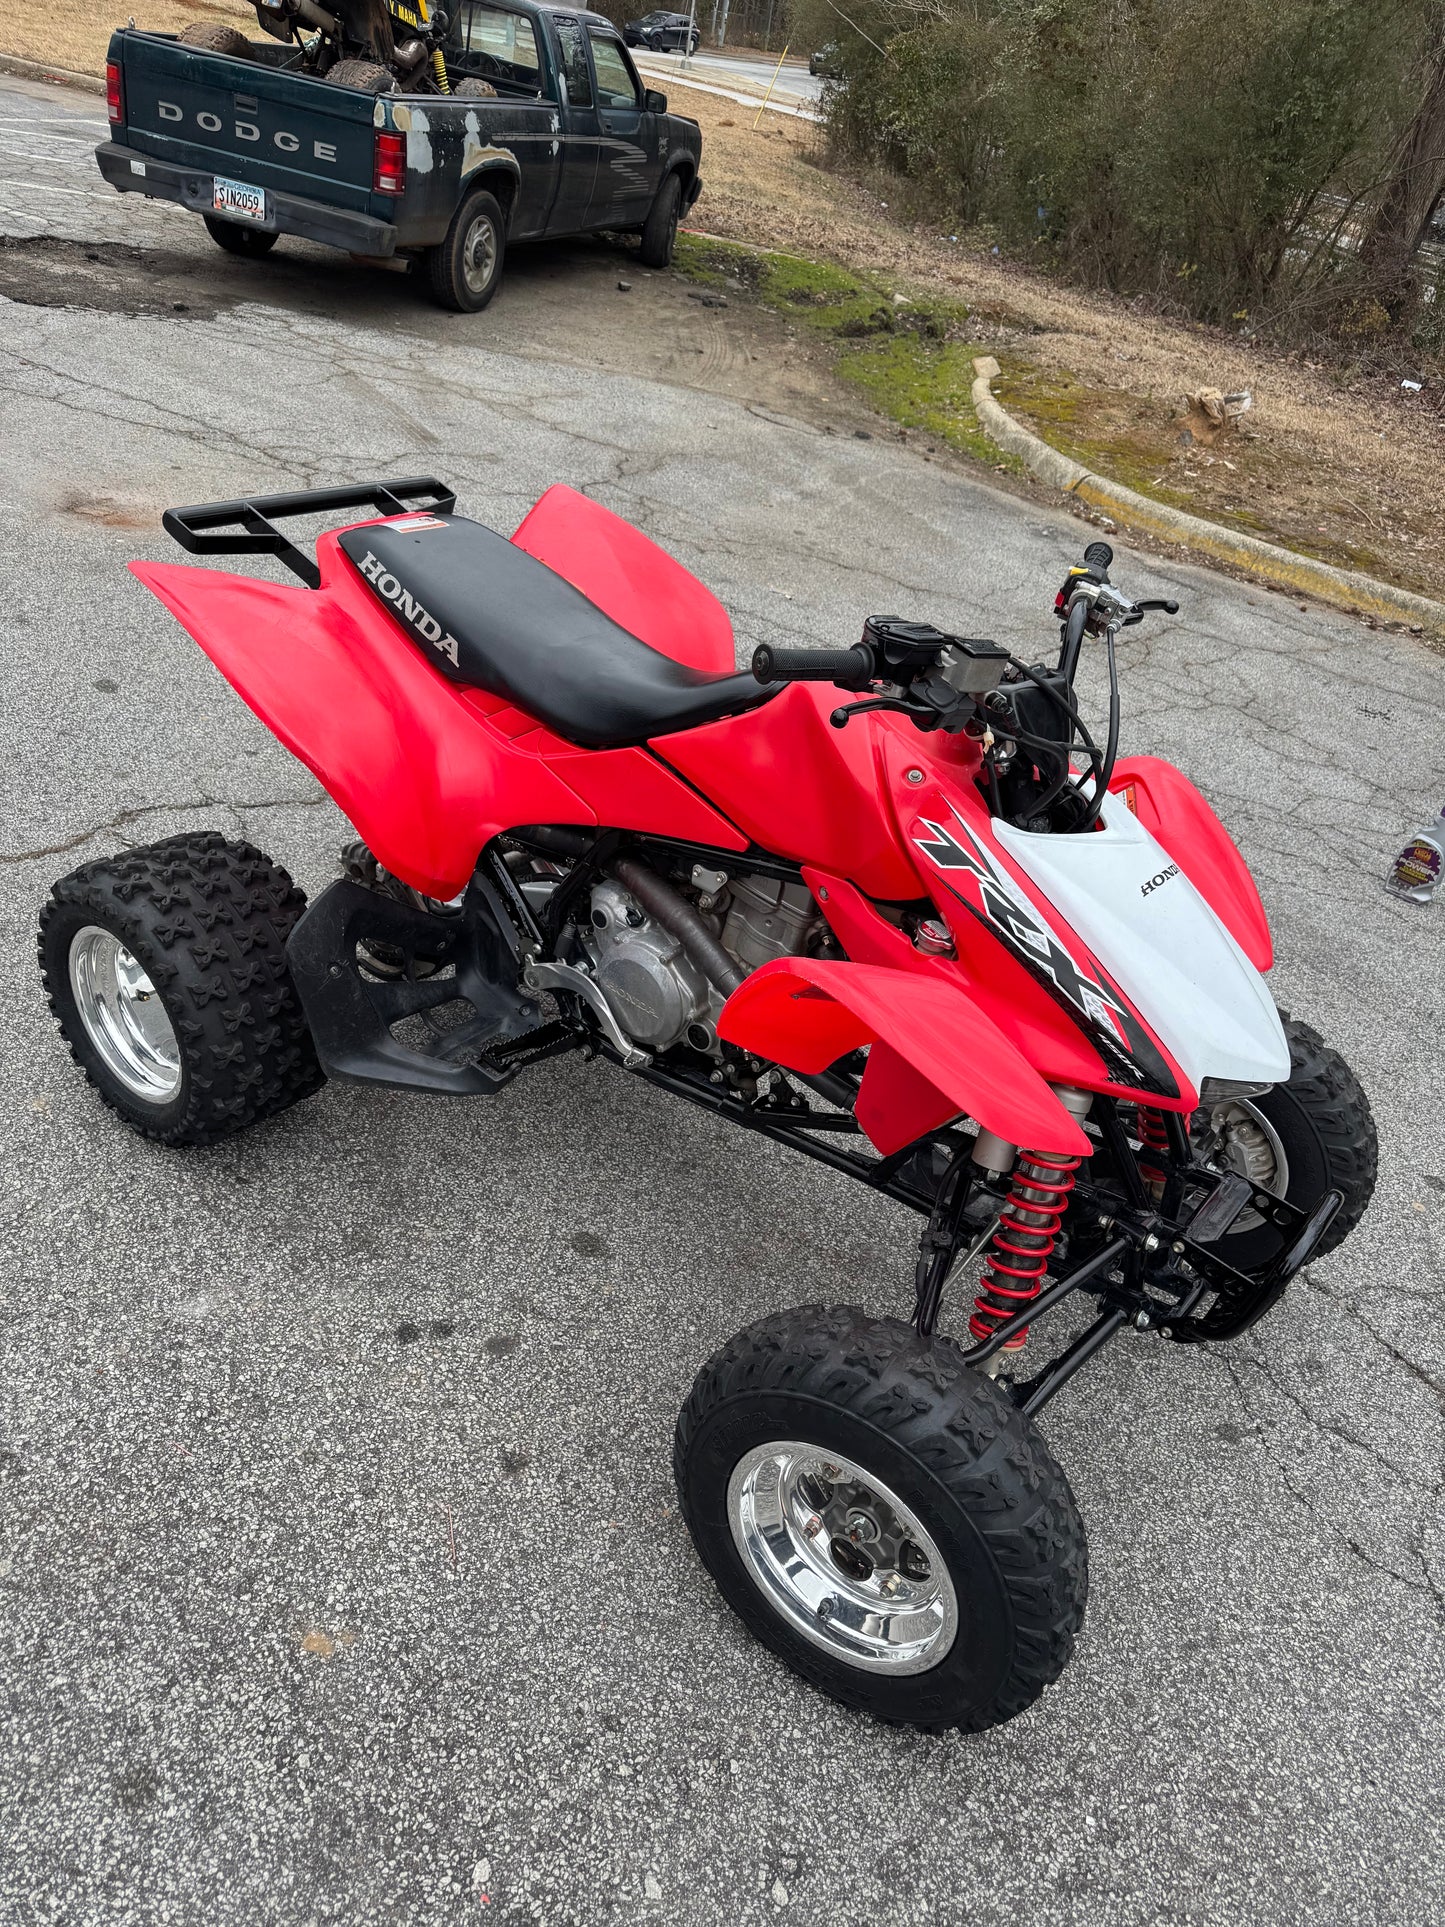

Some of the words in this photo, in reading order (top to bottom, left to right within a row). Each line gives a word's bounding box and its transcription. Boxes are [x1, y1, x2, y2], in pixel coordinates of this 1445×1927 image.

[389, 0, 417, 29] YMAHA
[158, 100, 337, 163] DODGE
[219, 187, 259, 211] SIN2059
[357, 550, 460, 669] HONDA
[1399, 857, 1436, 877] POWER
[911, 816, 1129, 1023] TRX
[1096, 1032, 1146, 1082] 450R
